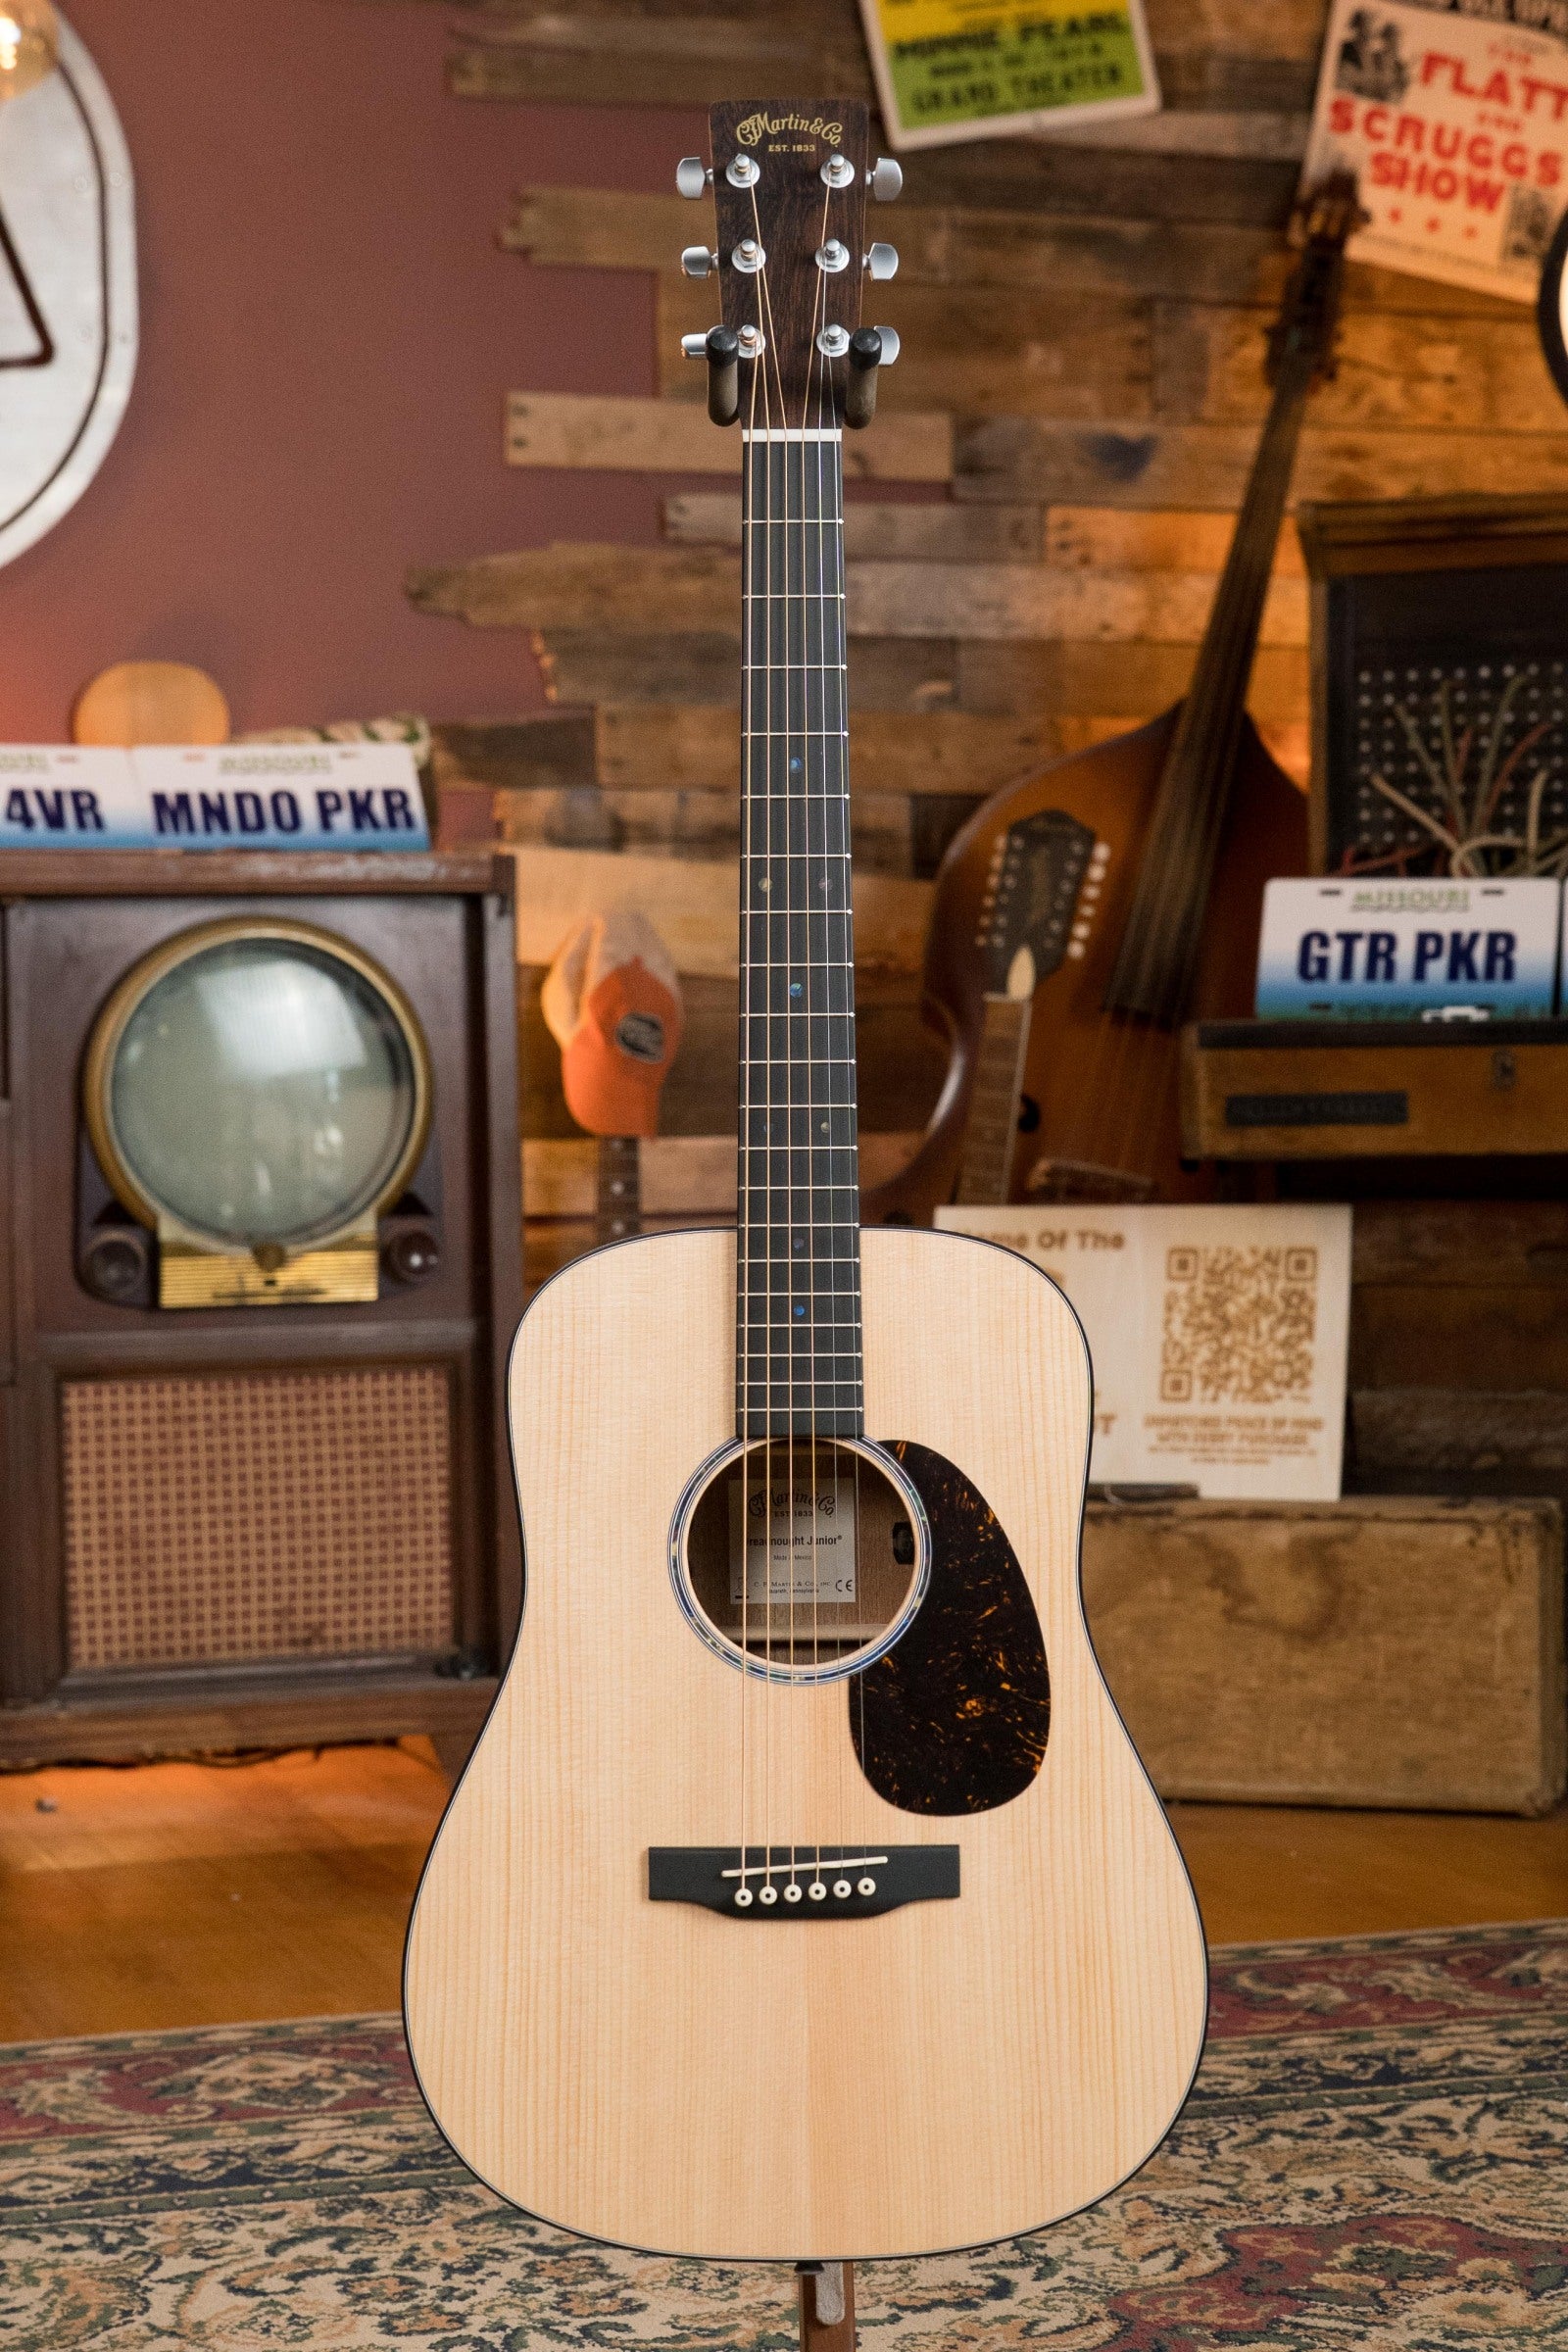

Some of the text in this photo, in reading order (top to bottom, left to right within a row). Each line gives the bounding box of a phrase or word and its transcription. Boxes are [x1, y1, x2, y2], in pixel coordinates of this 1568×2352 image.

[1421, 51, 1568, 122] FLATT
[1328, 95, 1562, 186] SCRUGGS
[1370, 151, 1505, 214] SHOW
[5, 788, 105, 832] 4VR
[151, 788, 417, 836] MNDO PKR
[1298, 930, 1517, 984] GTR PKR
[1038, 1229, 1067, 1250] Of
